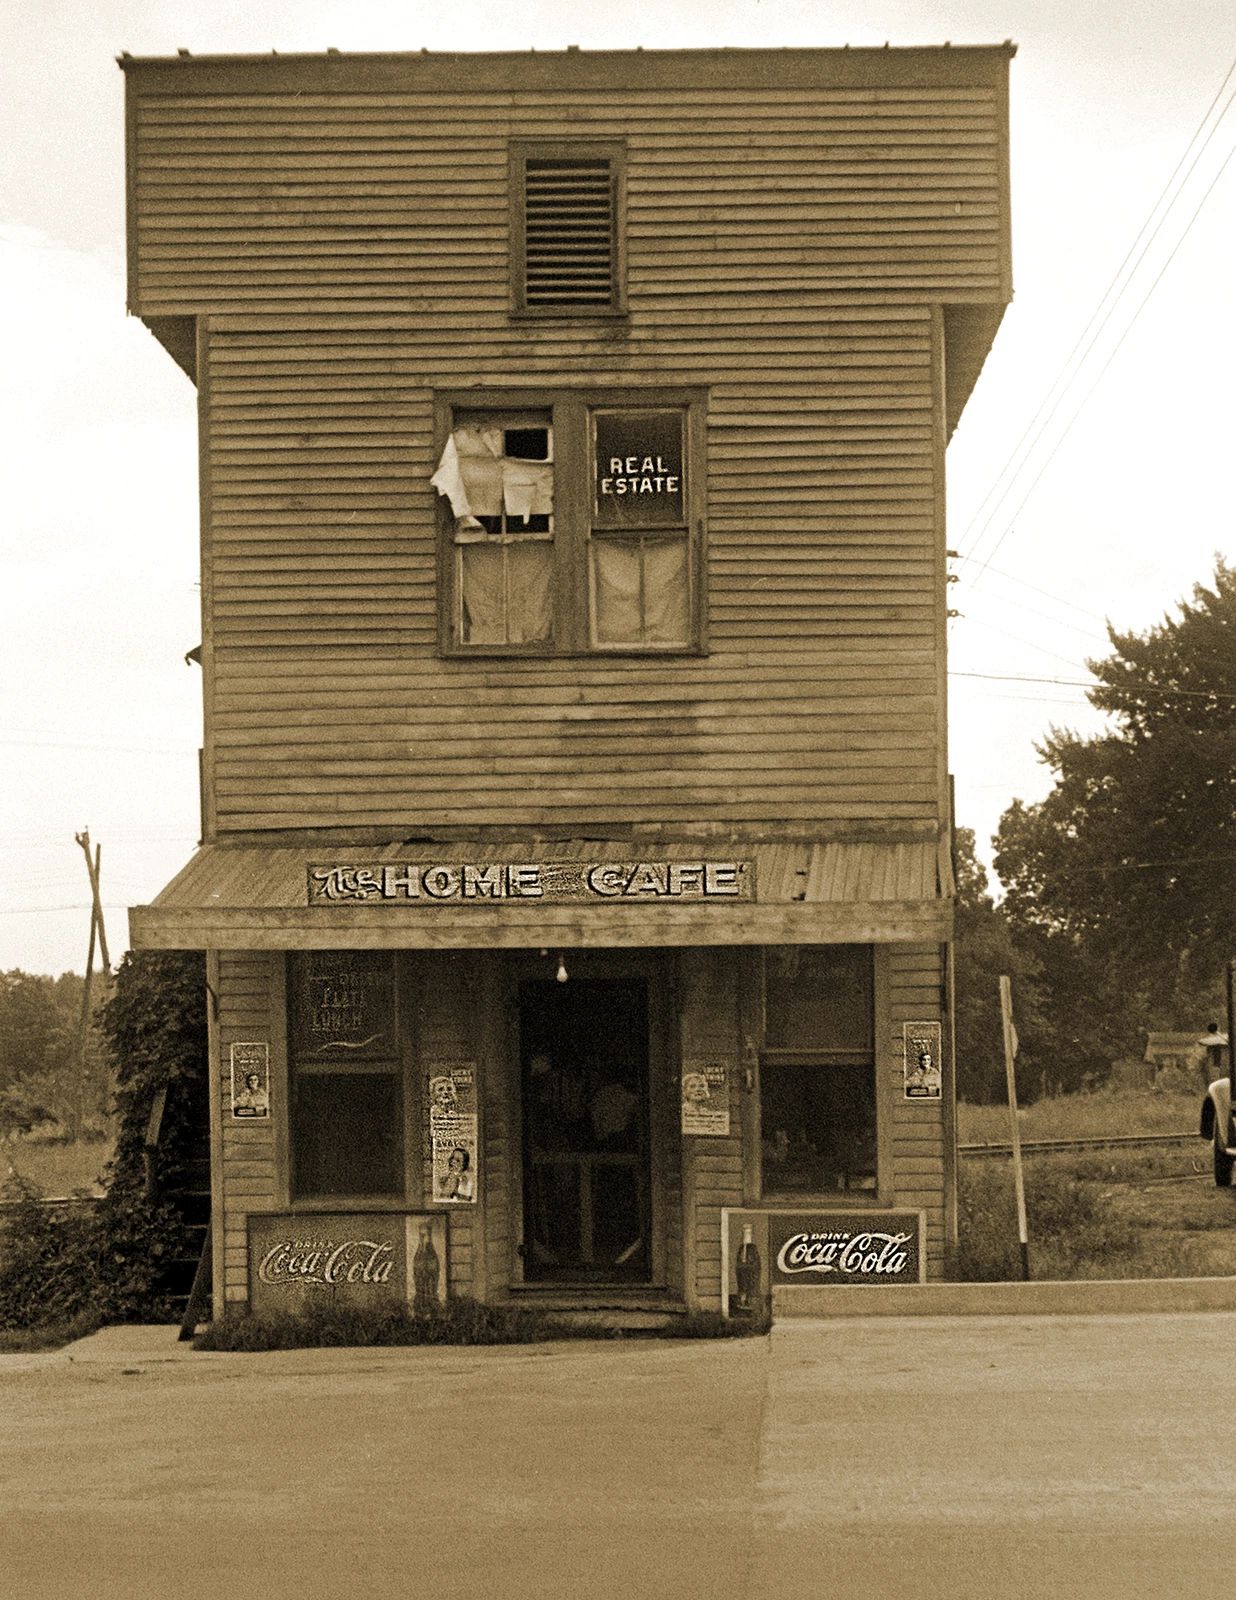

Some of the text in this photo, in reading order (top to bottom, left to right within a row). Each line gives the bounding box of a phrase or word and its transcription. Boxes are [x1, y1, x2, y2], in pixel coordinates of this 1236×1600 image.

[610, 456, 669, 474] REAL
[601, 476, 679, 494] ESTATE
[314, 866, 383, 899] The
[383, 864, 544, 898] HOME
[809, 1232, 852, 1241] DRINK
[258, 1240, 394, 1285] Coca-Cola
[777, 1232, 914, 1275] Coca-Cola
